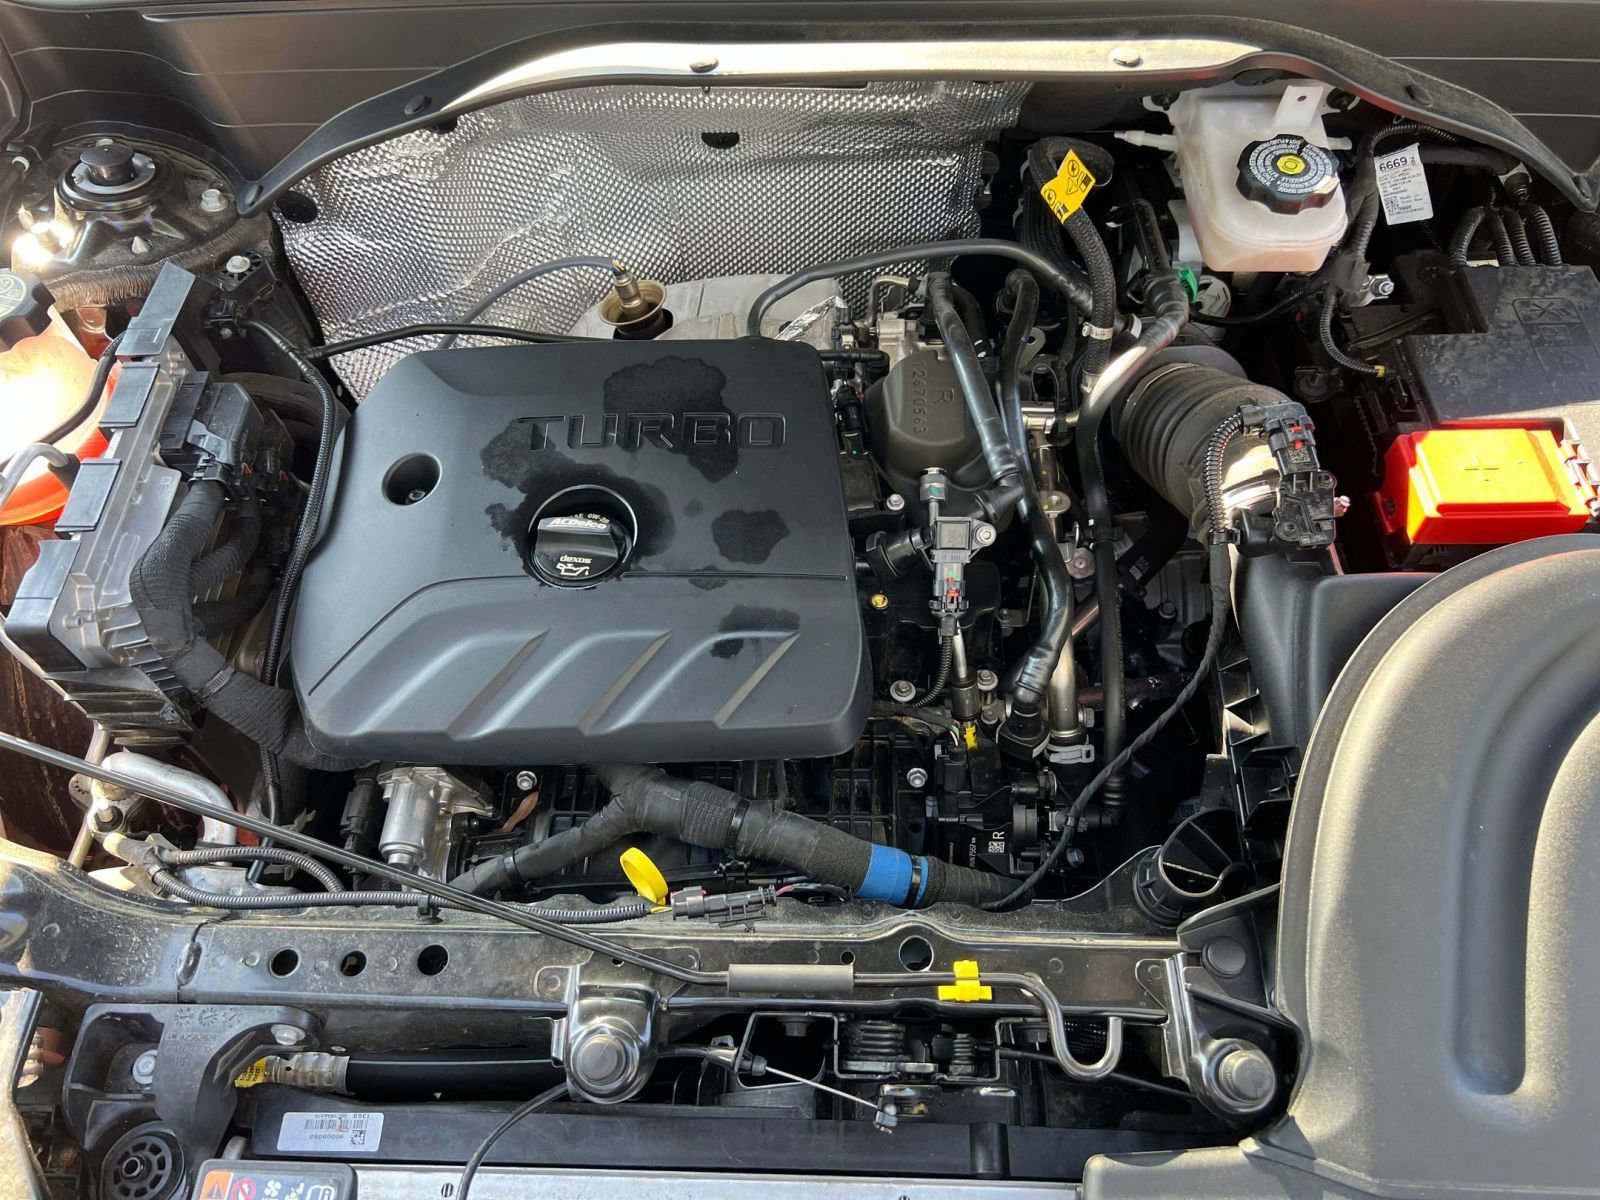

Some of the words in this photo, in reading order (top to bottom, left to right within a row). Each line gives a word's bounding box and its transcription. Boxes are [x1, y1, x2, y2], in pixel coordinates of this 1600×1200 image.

[1380, 156, 1408, 172] 6669
[518, 412, 786, 450] TURBO
[548, 518, 607, 530] ACDelco
[992, 832, 1004, 840] R
